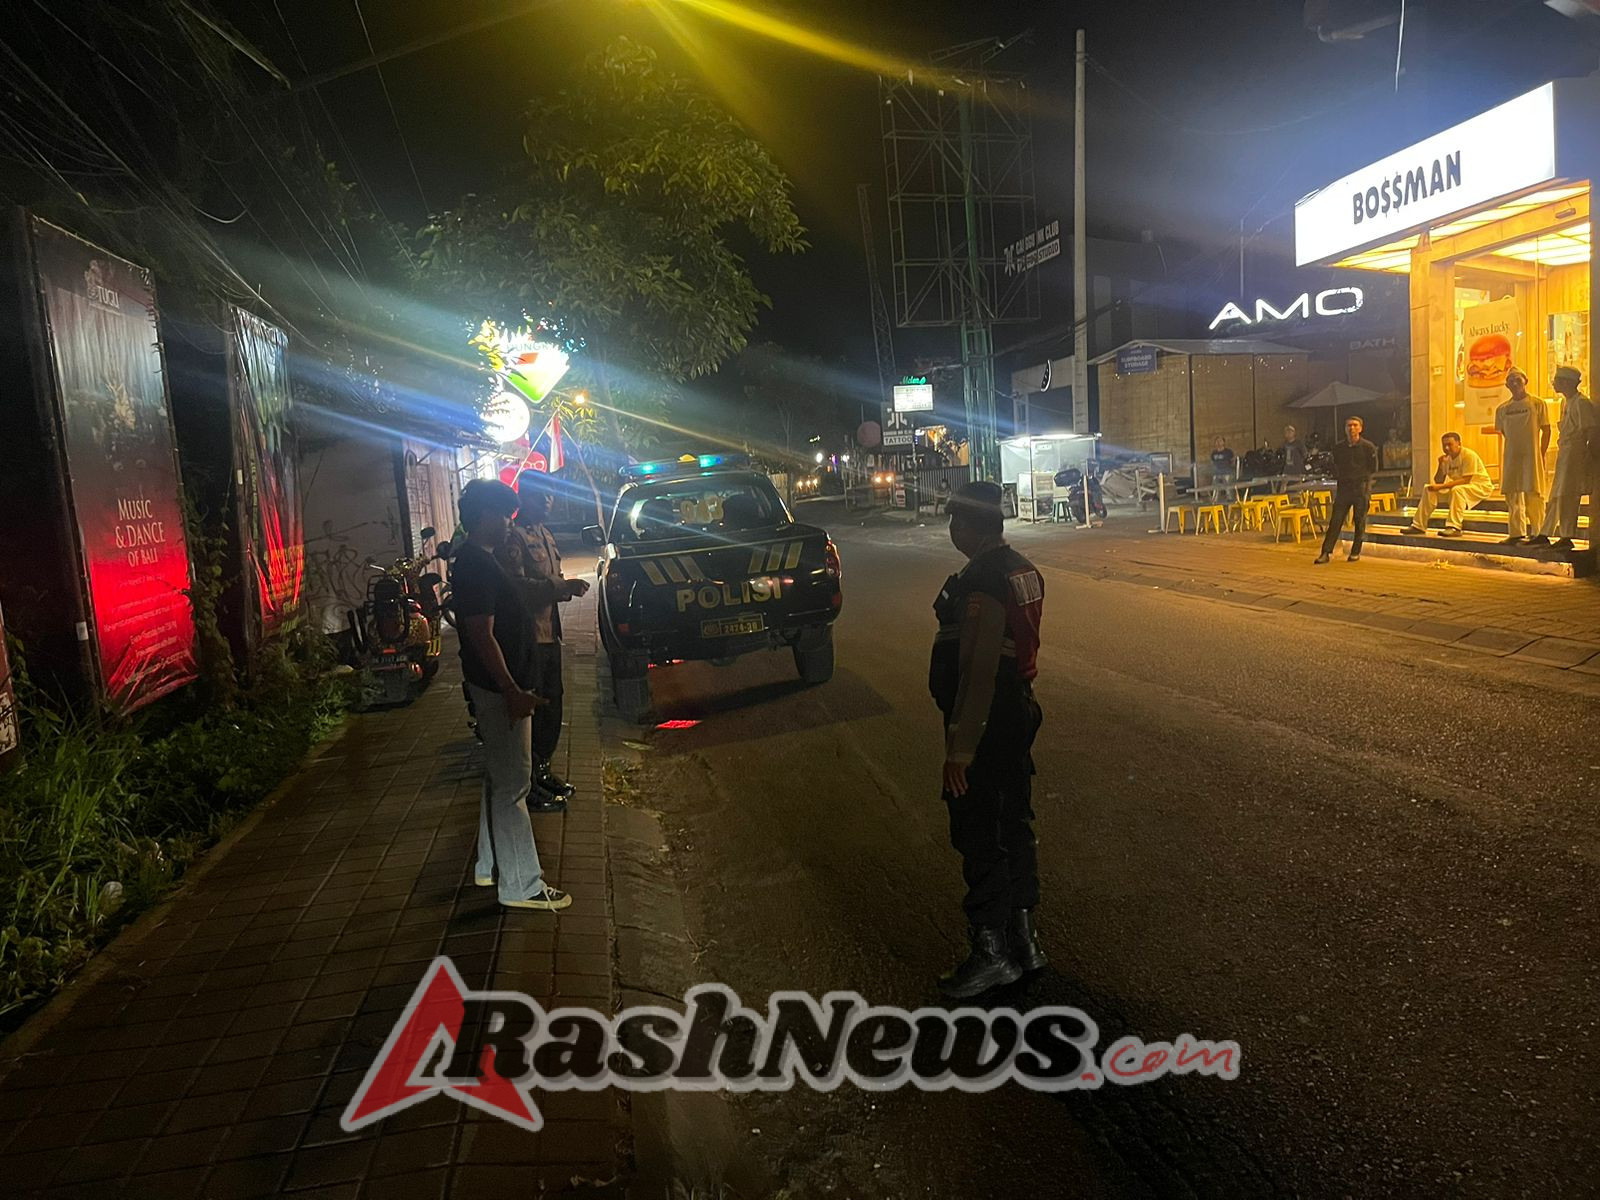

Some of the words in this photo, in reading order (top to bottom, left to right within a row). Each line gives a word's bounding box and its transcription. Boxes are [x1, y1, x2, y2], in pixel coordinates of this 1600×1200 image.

[1208, 287, 1363, 330] AMO
[885, 435, 912, 444] TATTOO
[115, 526, 126, 548] &
[126, 521, 166, 547] DANCE
[128, 551, 139, 567] OF
[140, 547, 158, 565] BALI
[677, 576, 782, 612] POLISI
